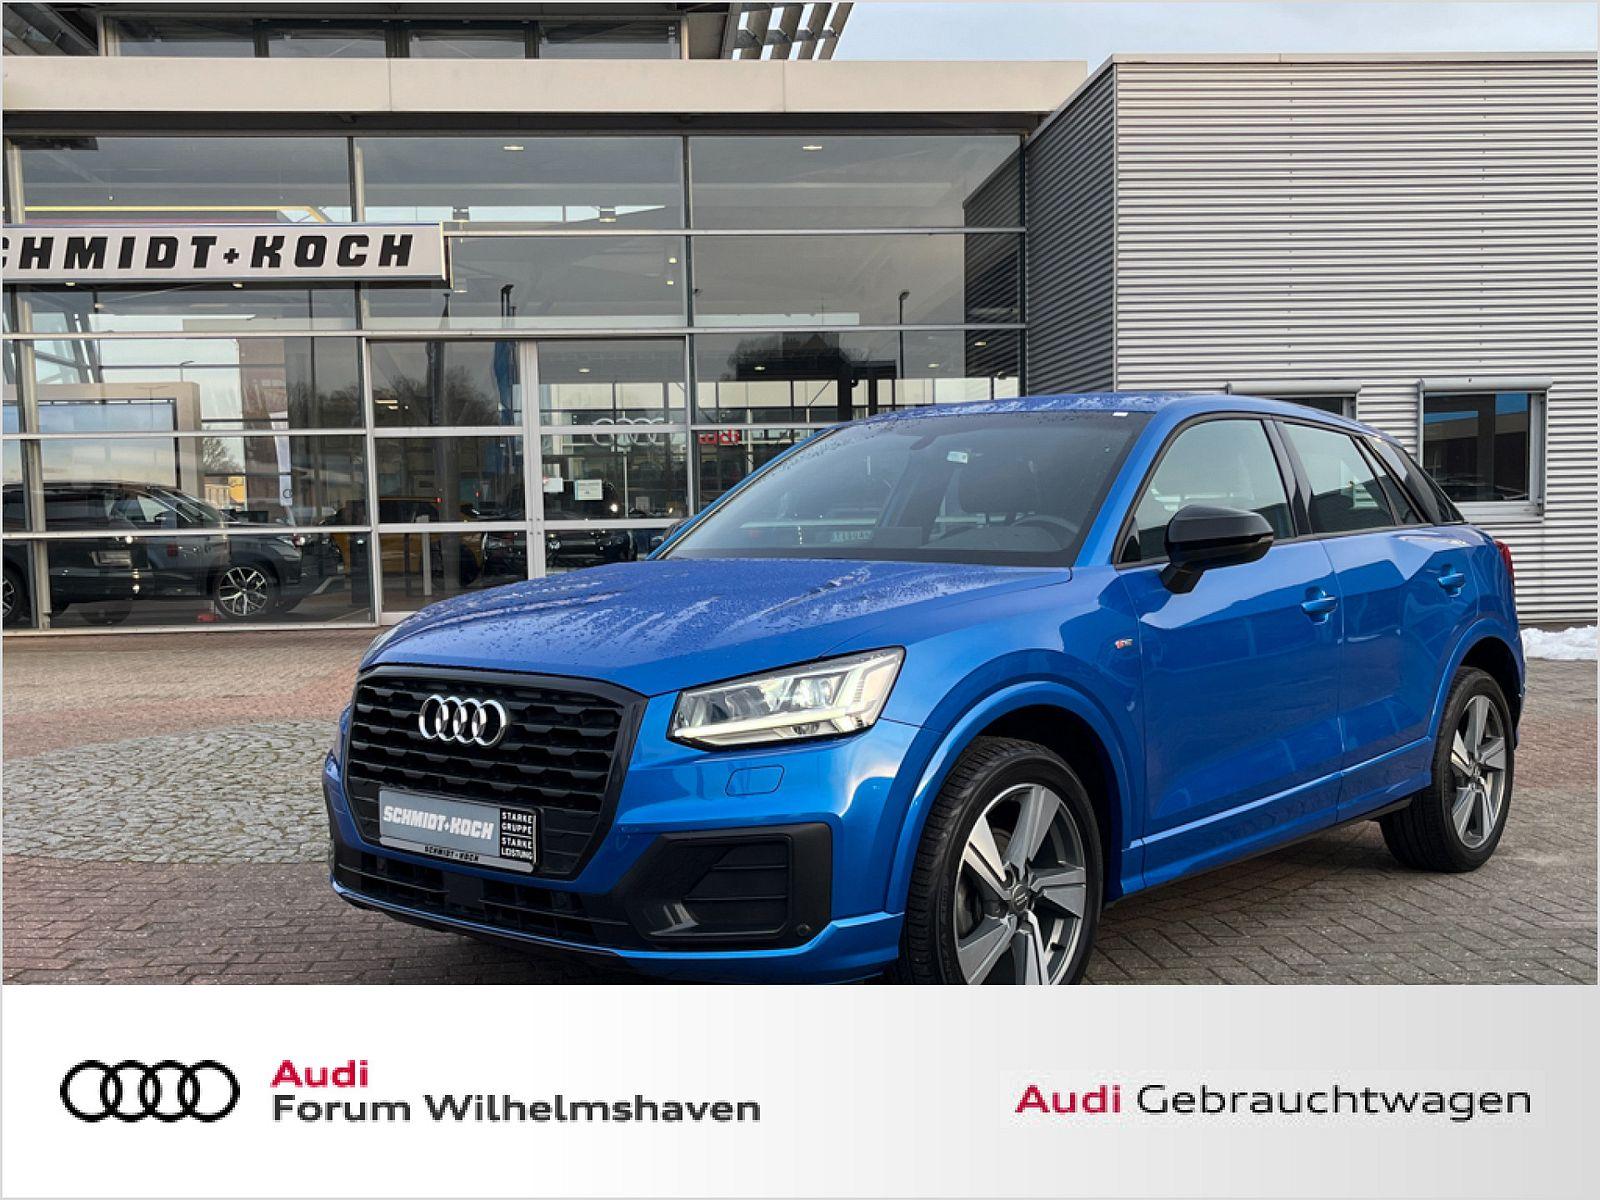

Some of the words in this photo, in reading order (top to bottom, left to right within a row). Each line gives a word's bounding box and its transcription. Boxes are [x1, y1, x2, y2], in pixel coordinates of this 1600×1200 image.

[2, 234, 413, 269] HMIDT+KOCH
[502, 811, 533, 823] STARKE
[502, 822, 532, 835] GRUPPE
[501, 837, 533, 849] STARKE
